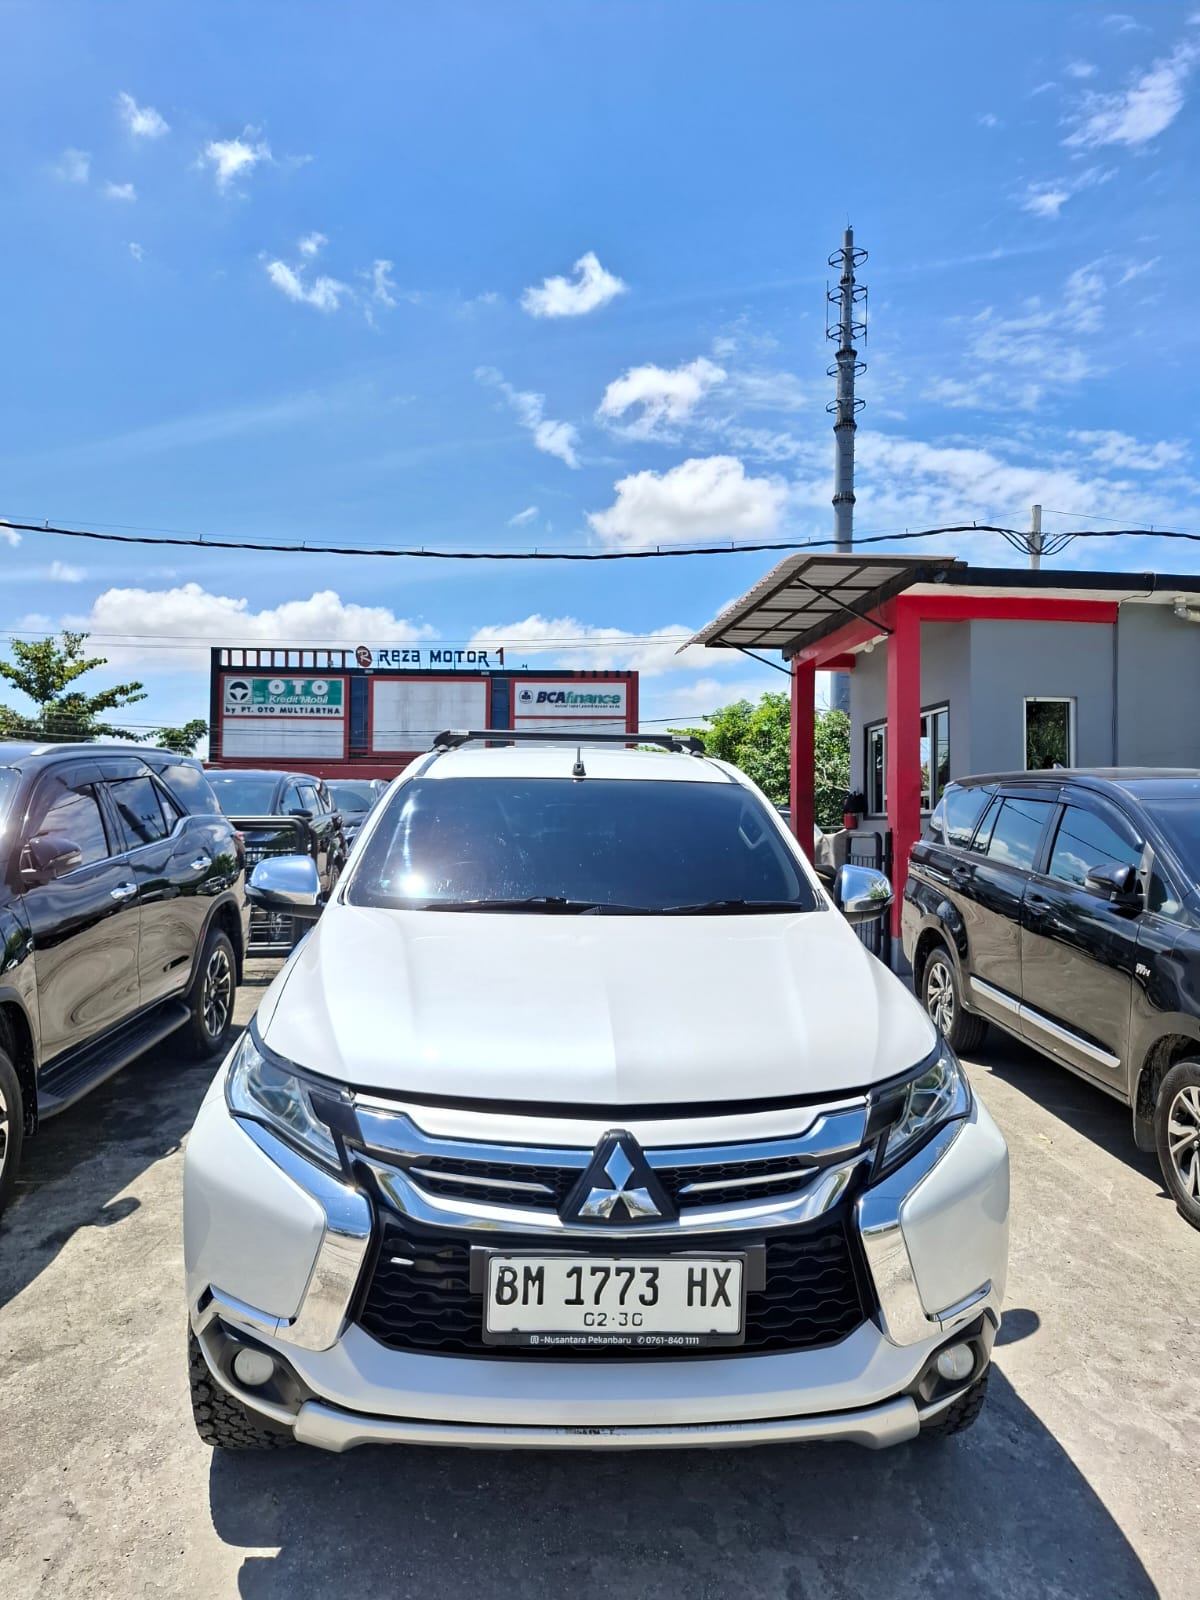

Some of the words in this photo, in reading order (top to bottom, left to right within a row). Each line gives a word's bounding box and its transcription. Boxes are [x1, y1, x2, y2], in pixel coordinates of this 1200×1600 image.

[430, 650, 490, 667] MOTOR
[495, 647, 504, 665] 1
[268, 679, 329, 695] OTO
[269, 695, 298, 704] Kredit
[301, 696, 328, 704] Mobil
[225, 706, 236, 714] by
[241, 706, 254, 714] PT.
[257, 706, 275, 714] OTO
[279, 706, 341, 715] MULTIARTHA
[495, 1266, 544, 1306] BM
[564, 1266, 659, 1306] 1773
[687, 1268, 732, 1307] HX
[588, 1336, 632, 1344] Pekanbaru
[645, 1336, 684, 1345] 0761-840
[685, 1337, 700, 1345] 1111
